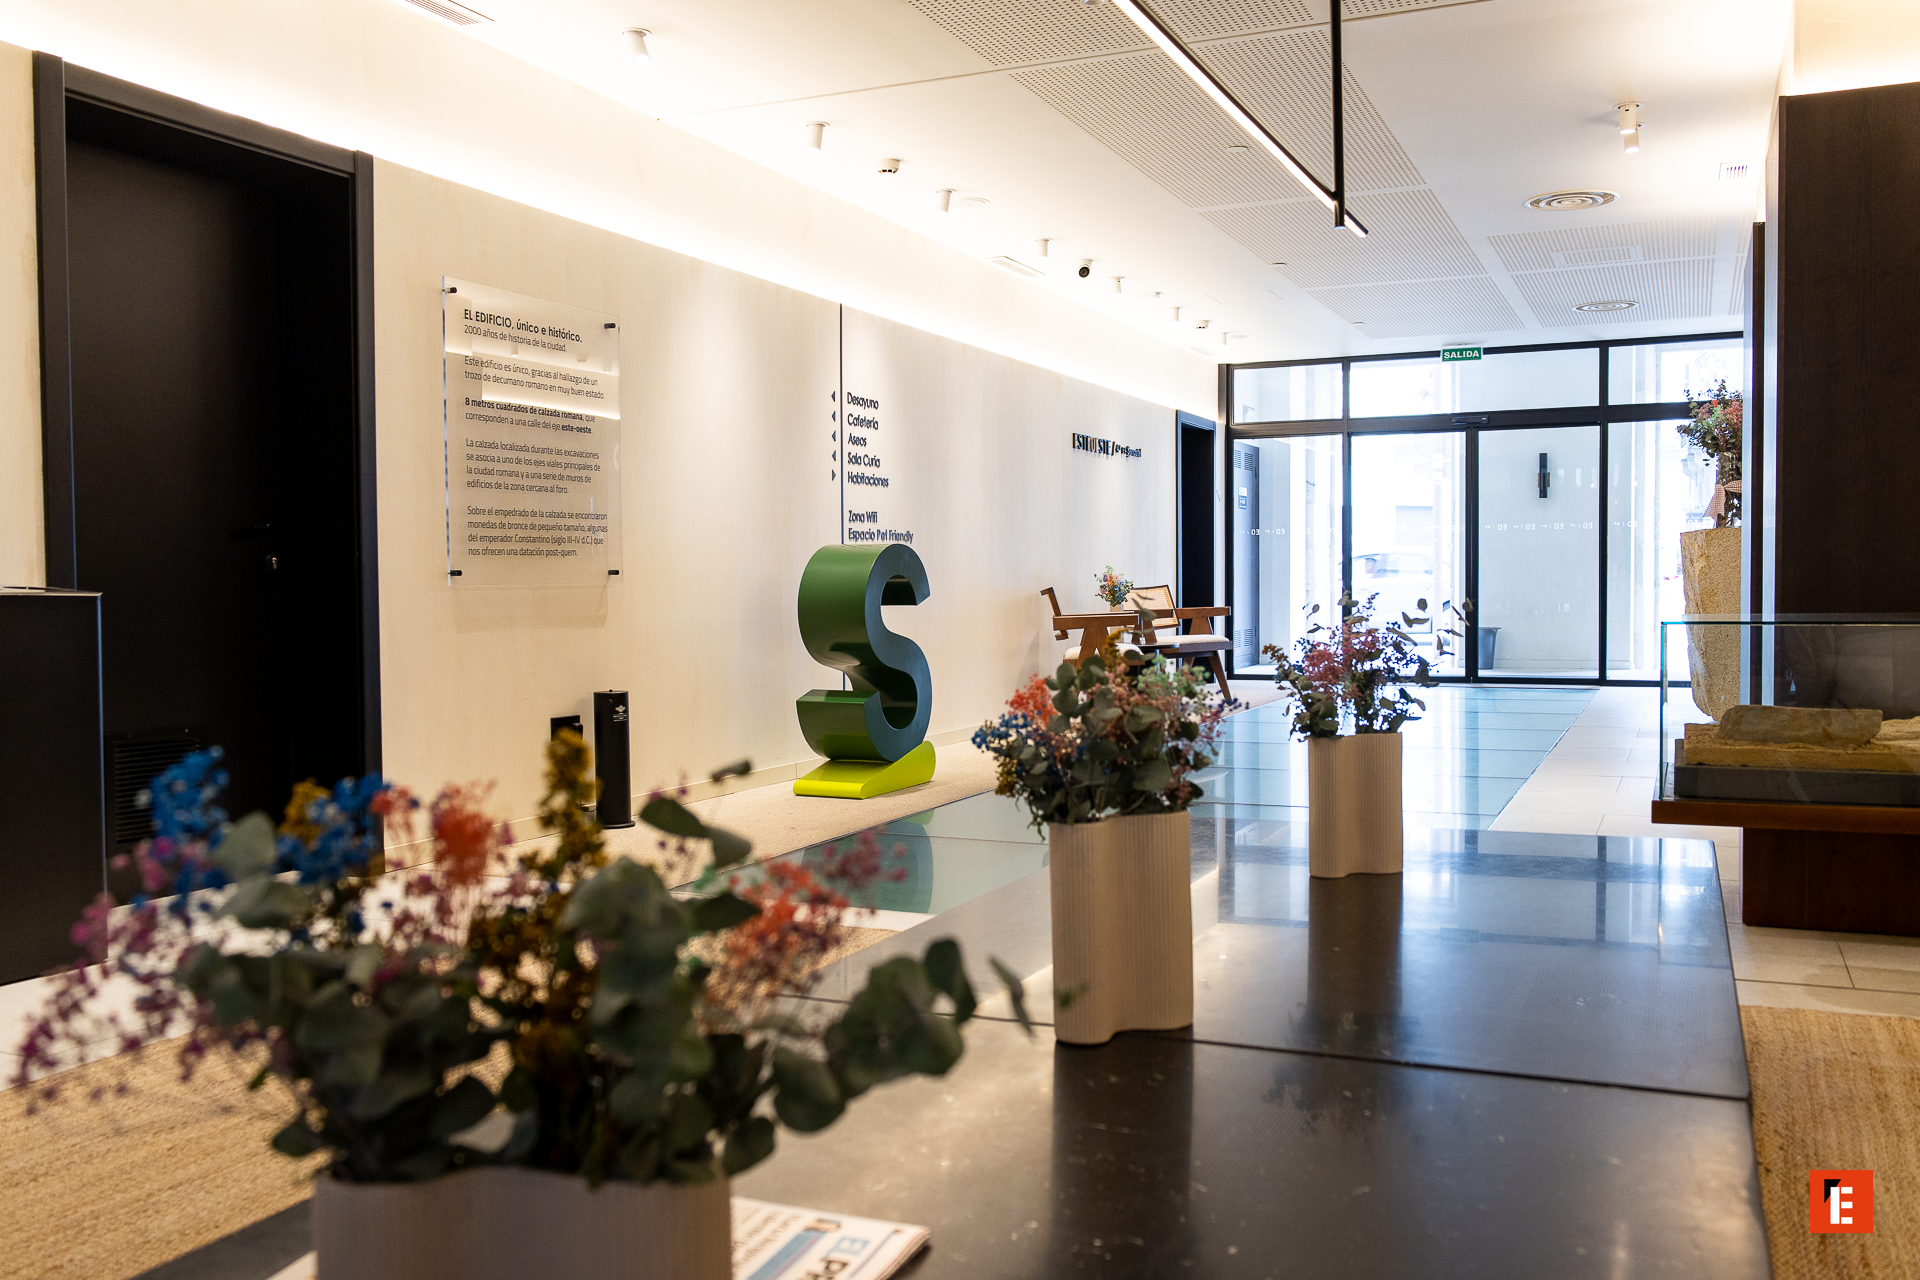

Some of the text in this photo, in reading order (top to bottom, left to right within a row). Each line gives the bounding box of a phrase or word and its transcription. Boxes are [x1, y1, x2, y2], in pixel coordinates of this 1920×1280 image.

[464, 308, 582, 343] EL EDIFICIO, único e histórico.
[464, 324, 568, 353] 2000 años de historia de la ciudad.
[1443, 350, 1480, 359] SALIDA
[464, 355, 480, 367] Este
[480, 357, 503, 371] edificio
[503, 364, 512, 372] es
[512, 363, 530, 376] único,
[531, 368, 552, 379] gracias
[552, 371, 559, 380] al
[559, 371, 582, 386] hallazgo
[583, 376, 591, 385] de
[464, 370, 606, 400] trozo de decumano romano en muy buen estado.
[847, 391, 879, 410] Desayuno
[465, 397, 596, 424] 8 metros cuadrados de calzada romana, que
[465, 412, 593, 435] corresponden a una calle del eje este-oeste.
[847, 413, 879, 430] Cafetería
[847, 432, 867, 447] Aseos
[466, 437, 600, 460] La calzada localizada durante las excavaciones
[466, 453, 474, 461] se
[475, 453, 496, 462] asocia
[501, 456, 514, 465] uno
[514, 456, 523, 465] de
[523, 456, 533, 466] los
[533, 457, 546, 468] ejes
[546, 459, 563, 469] viales
[563, 460, 593, 472] principales
[593, 463, 601, 472] de
[847, 451, 881, 468] Sala Curia
[466, 464, 592, 484] la ciudad romana y a una serie de muros de
[847, 471, 889, 488] Habitaciones
[466, 478, 570, 494] edificios de la zona cercana al foro.
[467, 505, 487, 516] Sobre
[487, 506, 494, 516] el
[494, 507, 530, 519] empedrado
[530, 508, 538, 517] de
[538, 508, 545, 518] la
[545, 509, 567, 519] calzada
[575, 512, 608, 521] encontraron
[848, 509, 878, 524] Zona Wifi
[467, 519, 609, 535] monedas de bronce de pequeño tamaño, algunas
[848, 527, 914, 544] Espacio Pet Friendly
[467, 532, 479, 542] del
[479, 533, 514, 544] emperador
[514, 533, 551, 544] Constantino
[551, 534, 567, 546] (siglo
[567, 535, 581, 544] III-IV
[593, 537, 604, 546] que
[468, 546, 578, 558] nos ofrecen una datación post-quem.
